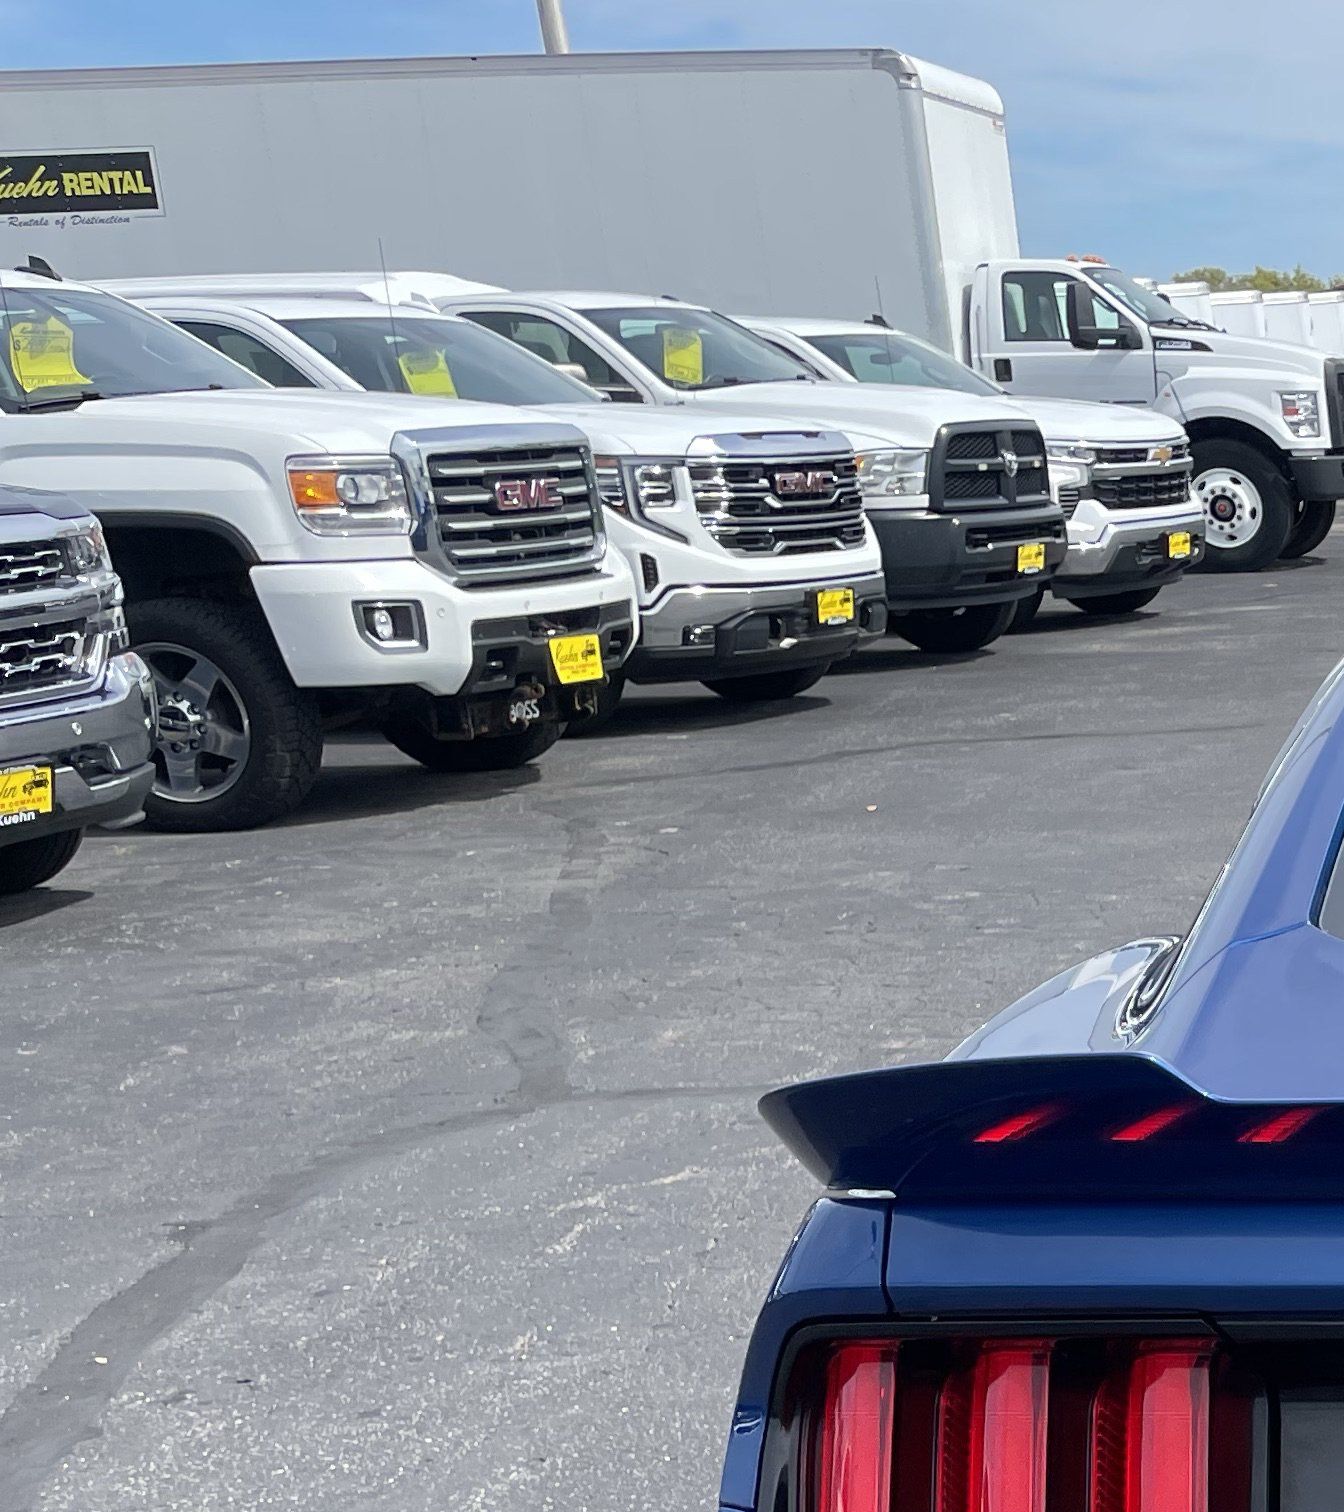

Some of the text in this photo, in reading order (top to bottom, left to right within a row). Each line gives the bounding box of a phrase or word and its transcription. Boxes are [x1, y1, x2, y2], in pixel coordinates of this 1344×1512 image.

[61, 170, 152, 197] RENTAL
[8, 214, 131, 229] Rentals of Distinction
[494, 477, 563, 511] GMC
[774, 471, 838, 494] GMC
